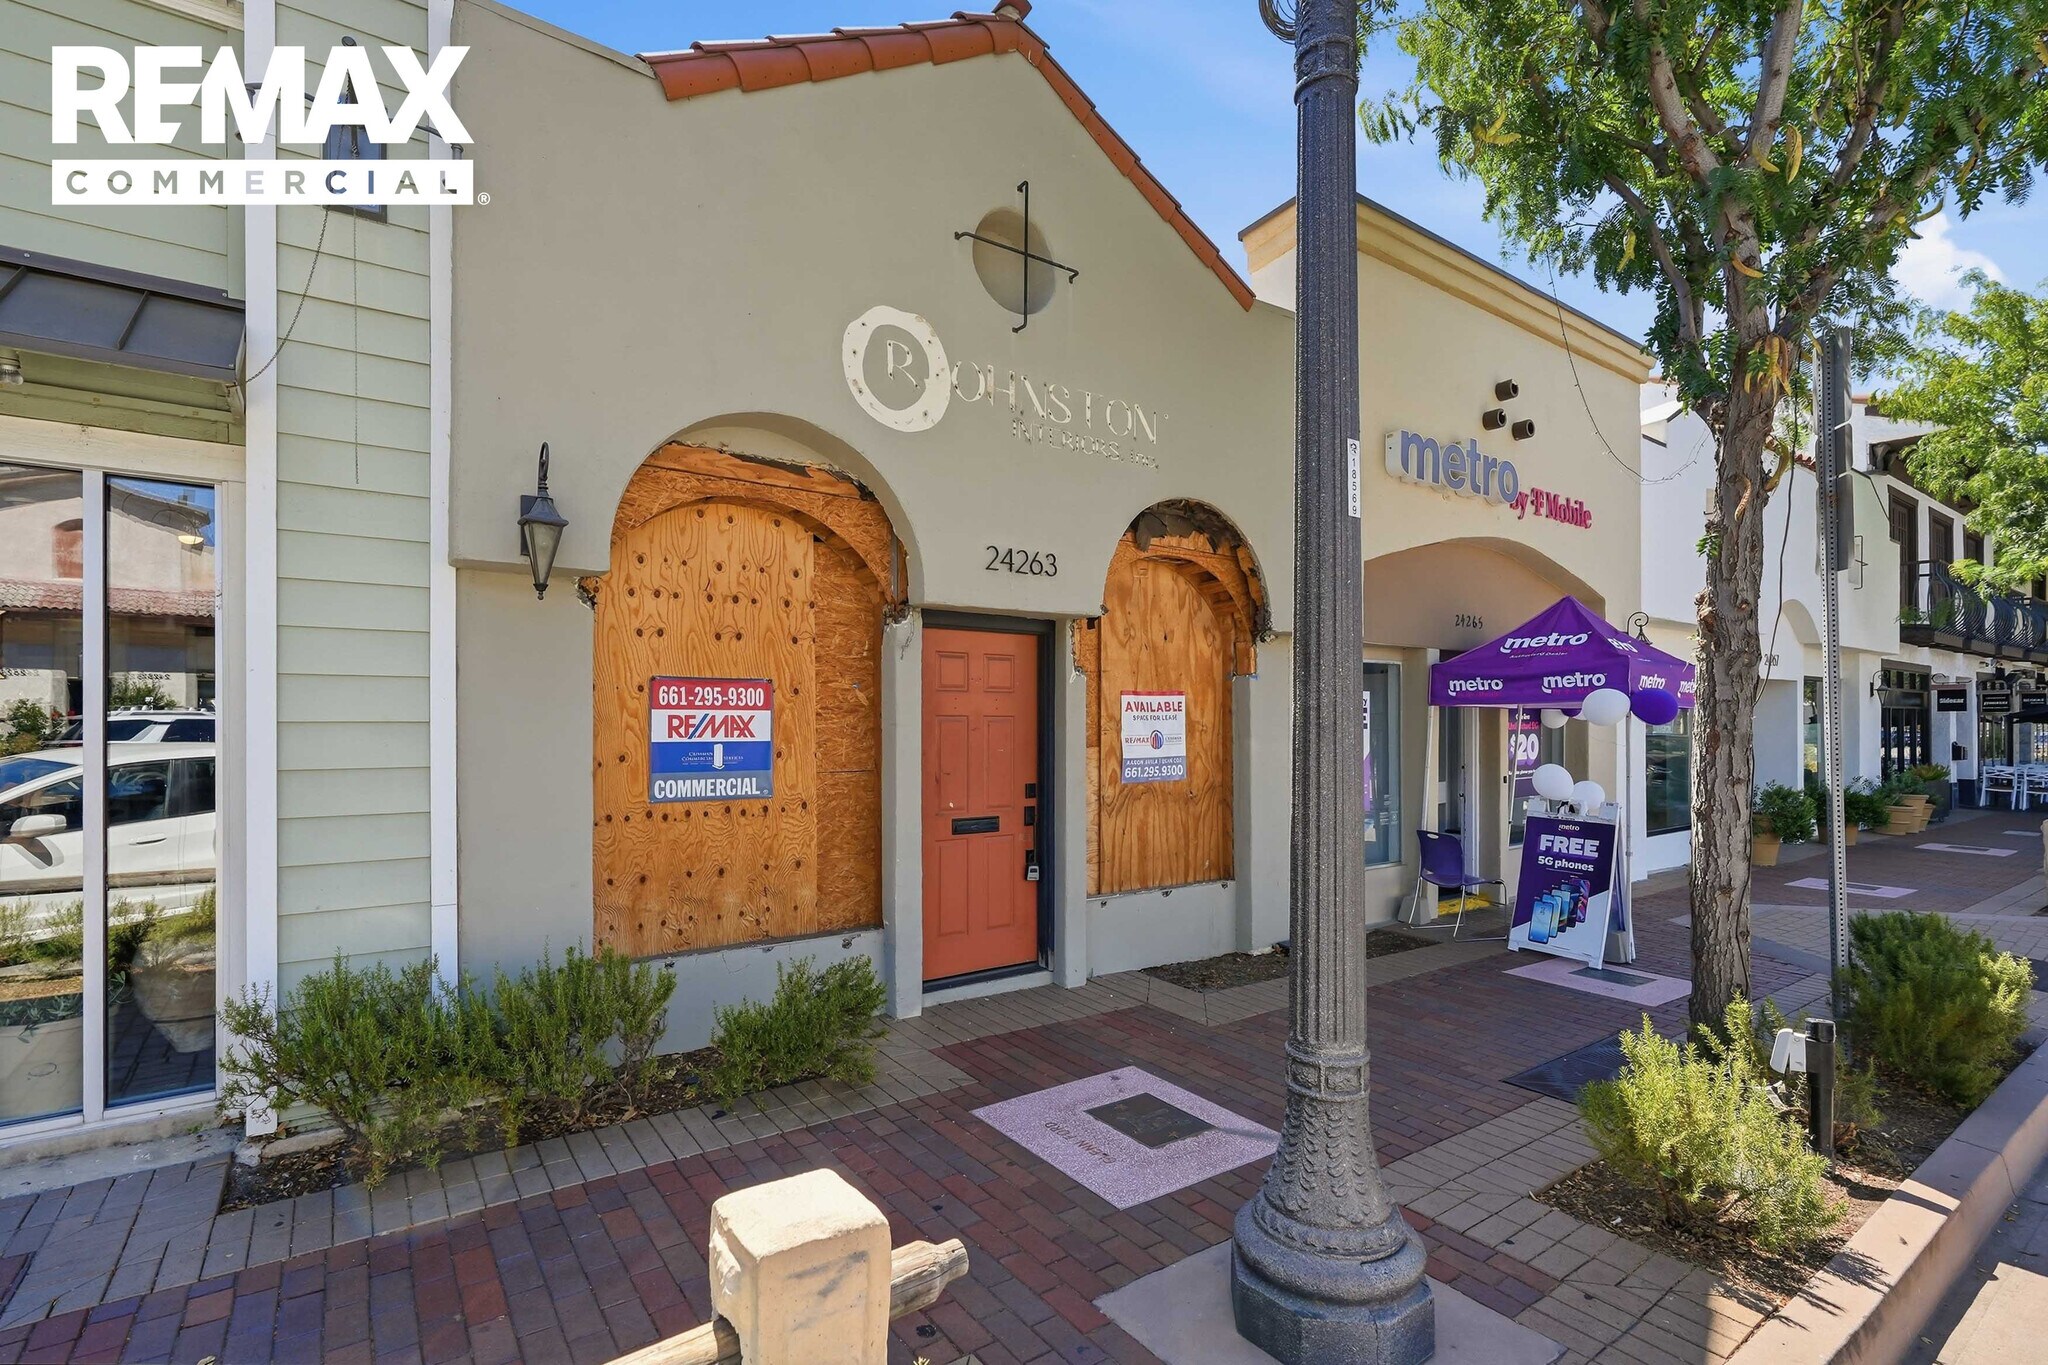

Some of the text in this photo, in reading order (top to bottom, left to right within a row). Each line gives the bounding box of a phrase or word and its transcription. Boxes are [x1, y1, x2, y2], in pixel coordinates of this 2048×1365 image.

[1400, 429, 1519, 503] metro
[985, 545, 1058, 577] 24263
[1455, 614, 1483, 629] 24265
[1500, 632, 1589, 653] metro
[1448, 677, 1504, 697] metro
[1541, 672, 1606, 694] metro
[1638, 674, 1666, 691] metro
[658, 685, 765, 707] 661-295-9300
[1125, 701, 1183, 712] AVAILABLE
[667, 713, 756, 740] RE/MAX
[1125, 736, 1150, 744] RE/MAX
[1124, 764, 1184, 778] 661.295.9300
[654, 777, 761, 799] COMMERCIAL
[1539, 834, 1600, 858] FREE
[1537, 855, 1554, 866] 5G
[1554, 859, 1594, 872] phones
